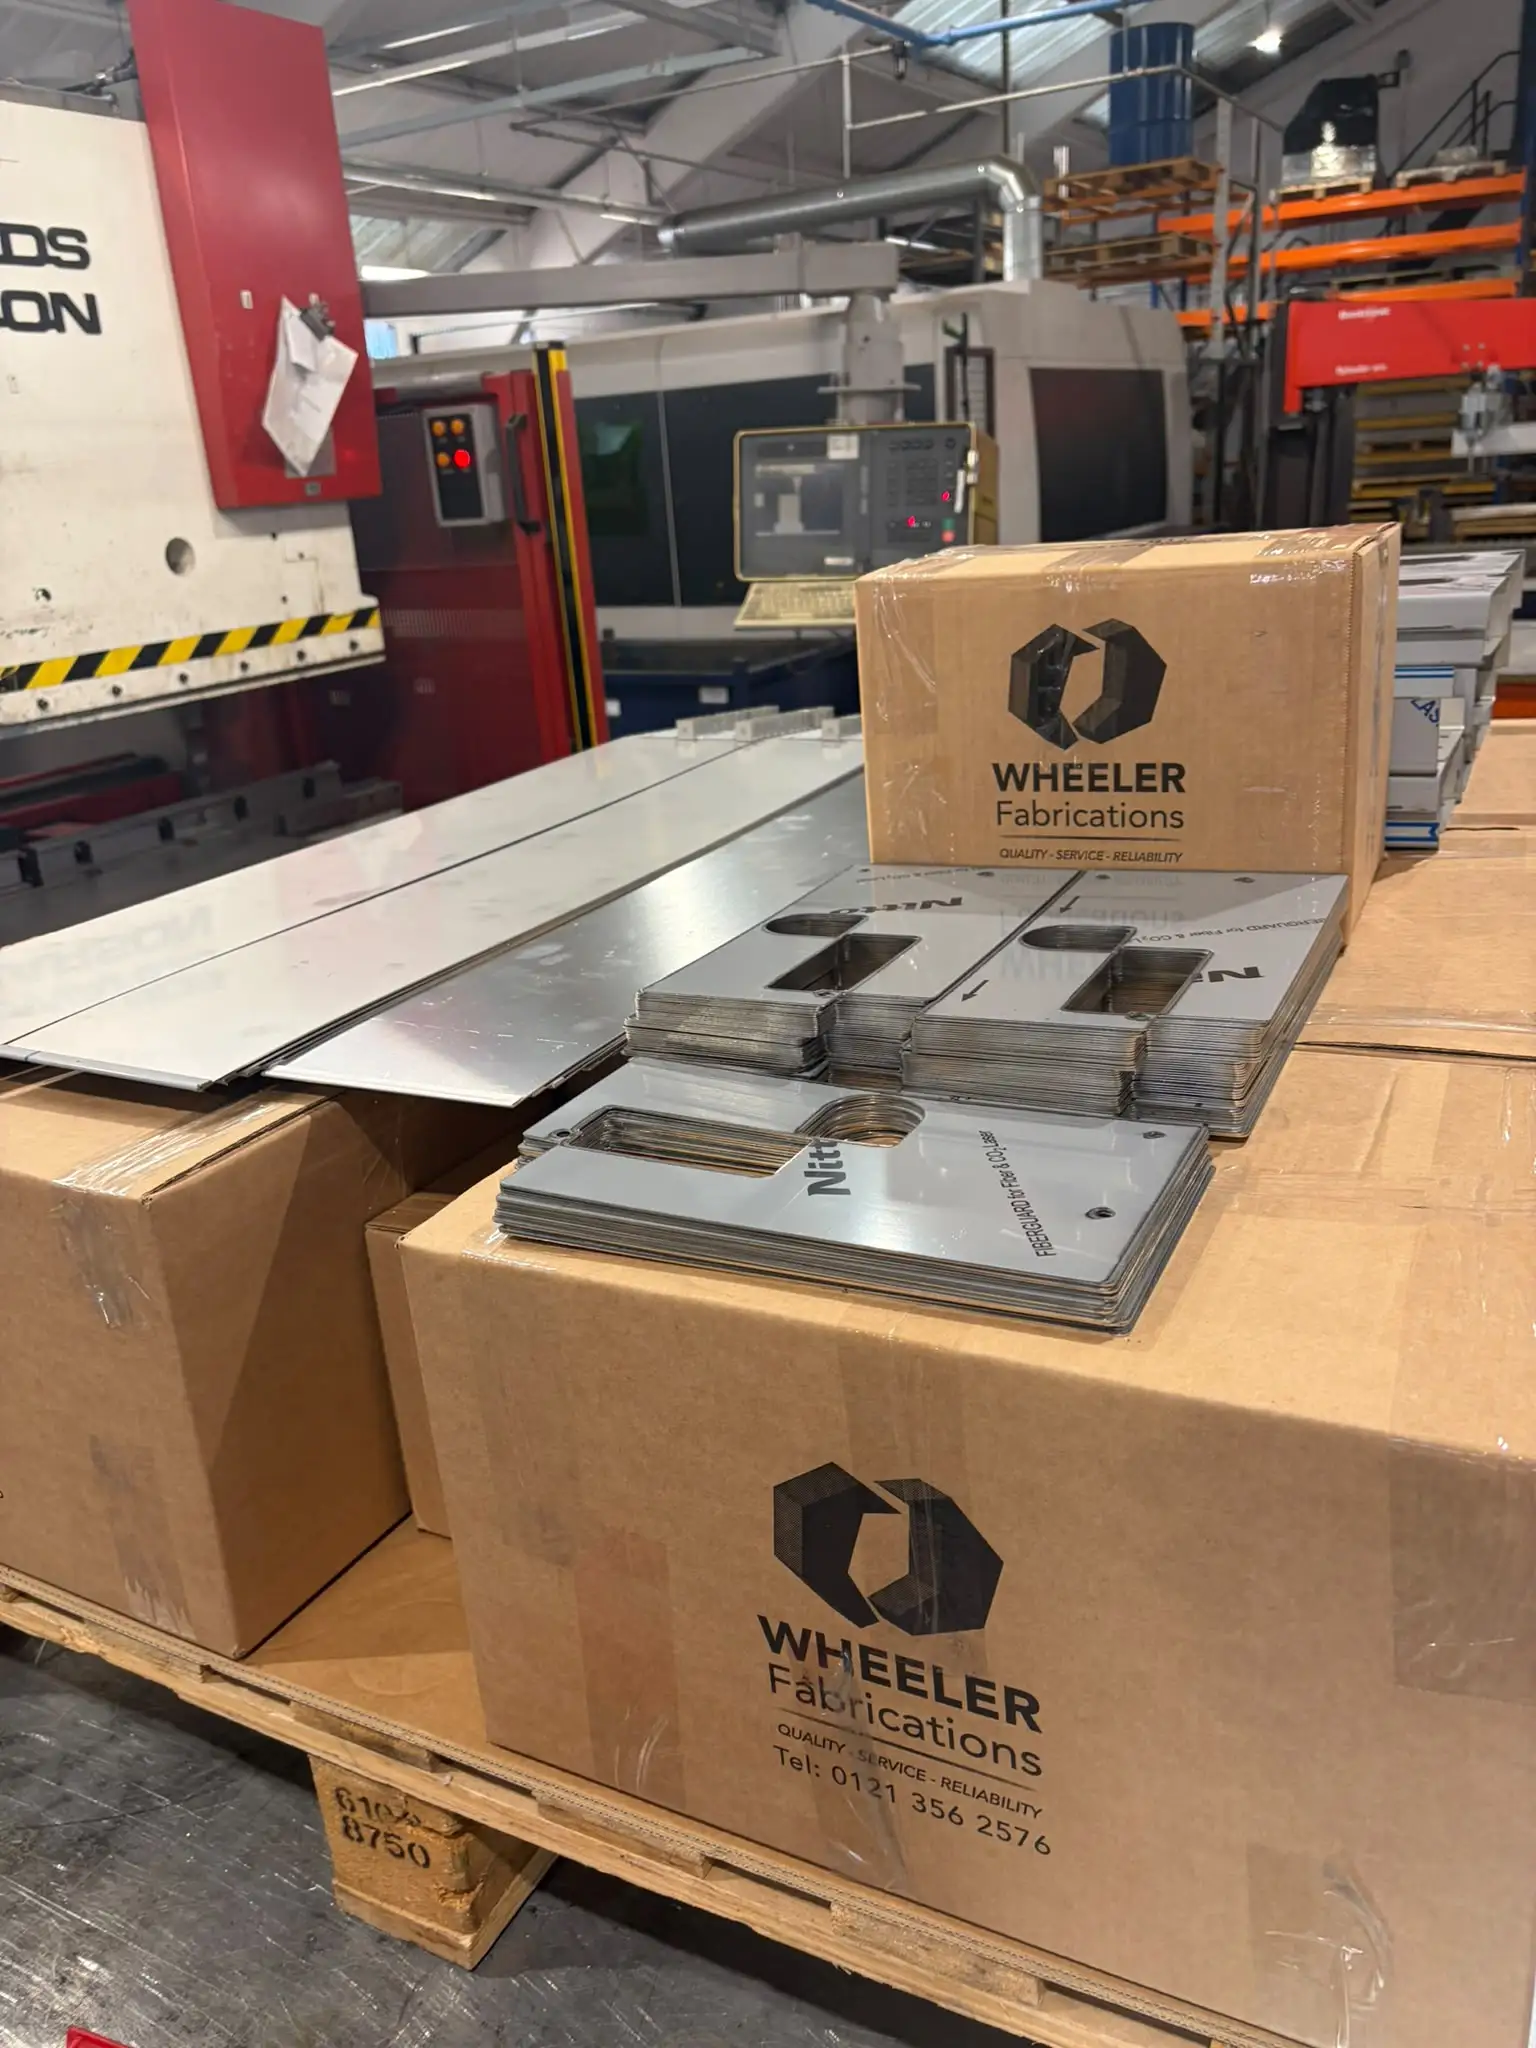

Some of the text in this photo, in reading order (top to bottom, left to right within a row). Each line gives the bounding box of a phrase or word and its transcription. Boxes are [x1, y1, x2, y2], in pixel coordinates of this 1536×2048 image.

[992, 762, 1186, 793] WHEELER
[997, 799, 1185, 829] Fabrications
[1000, 848, 1048, 860] QUALITY
[1056, 850, 1104, 861] SERVICE
[1113, 851, 1183, 863] RELIABILITY
[978, 1130, 1000, 1148] Laser
[999, 1170, 1021, 1188] Fiber
[1007, 1188, 1026, 1199] for
[1010, 1200, 1057, 1257] FIBERGUARD
[757, 1614, 1043, 1734] WHEELER
[769, 1662, 1042, 1777] Fabrications
[778, 1723, 846, 1754] QUALITY
[857, 1750, 927, 1782] SERVICE
[940, 1776, 1043, 1819] RELIABILITY
[773, 1744, 1051, 1856] Tel: 0121 356 2576
[342, 1815, 431, 1869] 8750
